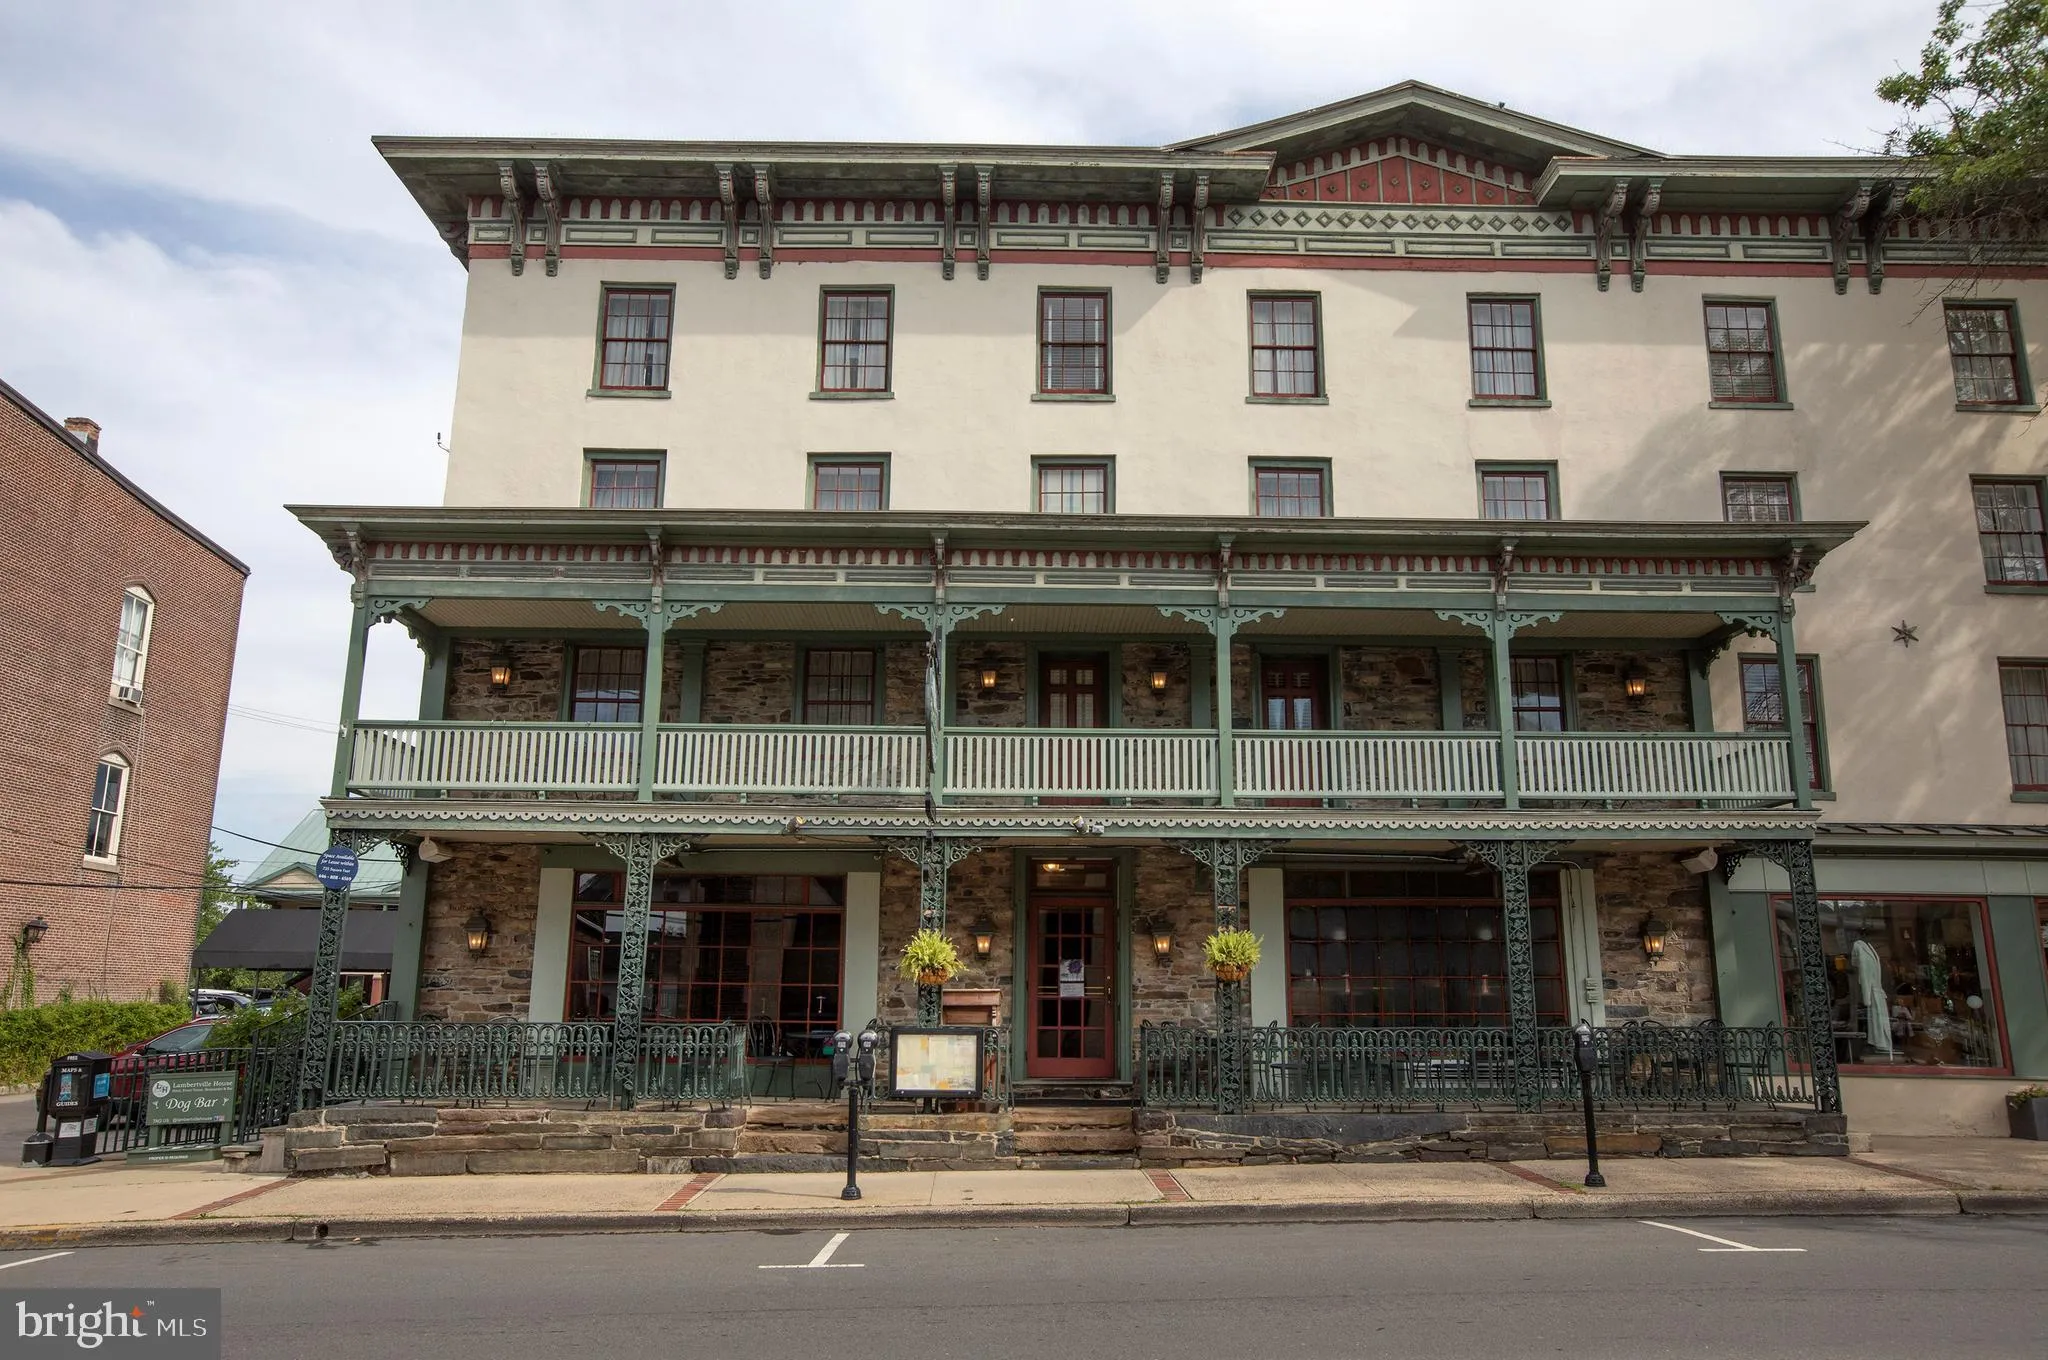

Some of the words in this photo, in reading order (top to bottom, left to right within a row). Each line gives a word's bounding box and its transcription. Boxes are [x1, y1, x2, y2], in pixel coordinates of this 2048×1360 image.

[172, 1081, 212, 1089] Lambertville
[166, 1098, 192, 1112] Dog
[194, 1096, 218, 1108] Bar
